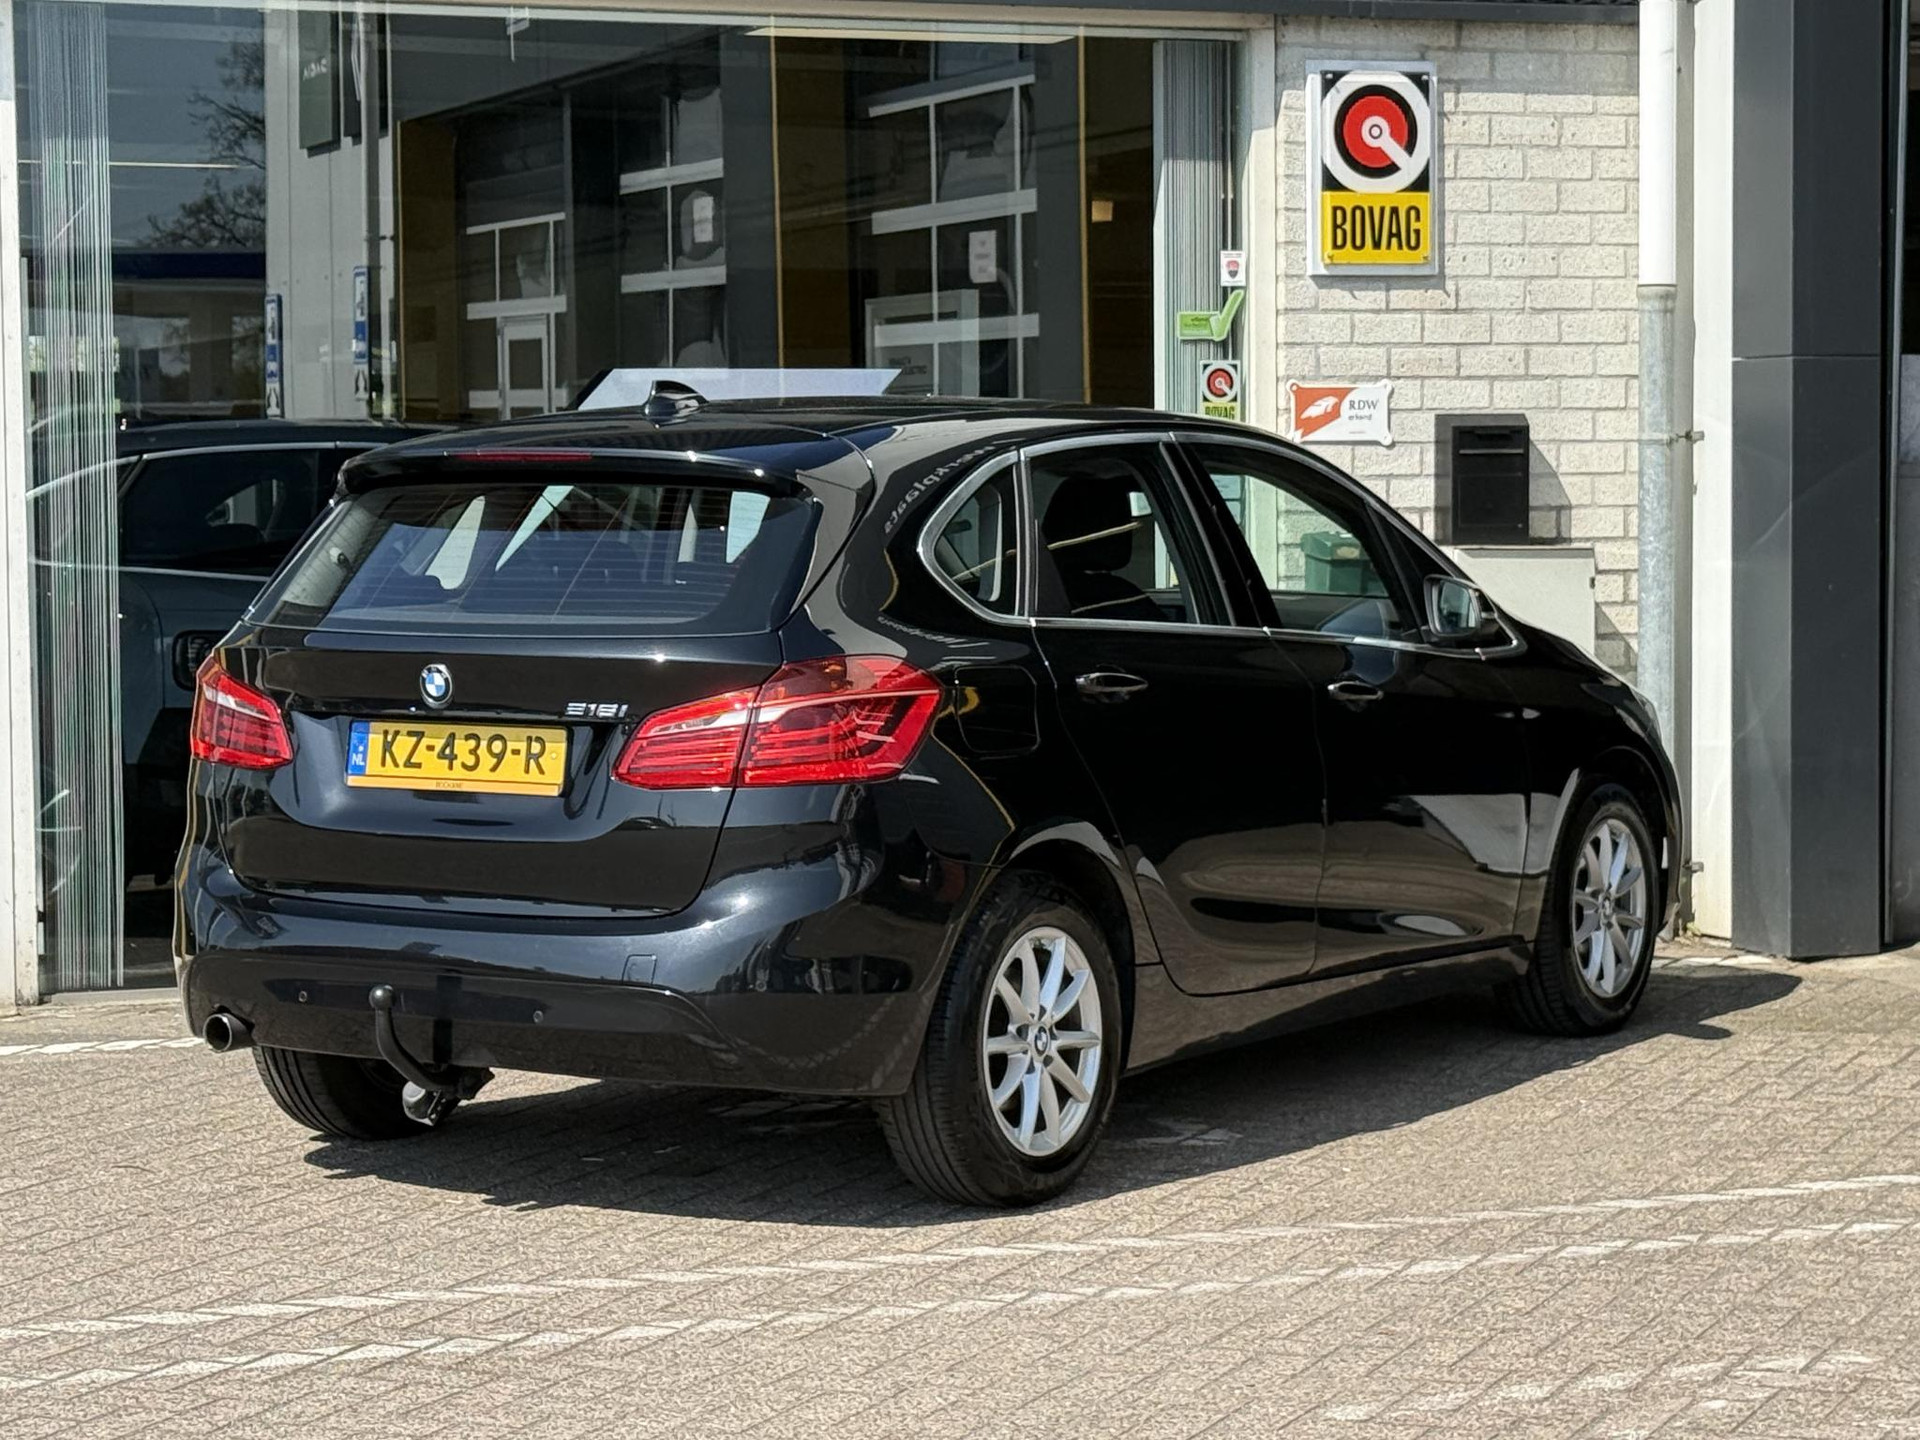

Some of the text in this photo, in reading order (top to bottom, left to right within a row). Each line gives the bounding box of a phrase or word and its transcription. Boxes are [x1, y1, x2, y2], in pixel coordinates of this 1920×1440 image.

[1331, 204, 1421, 251] BOVAG
[1348, 398, 1379, 410] RDW
[1204, 405, 1236, 421] BOVAG
[351, 752, 366, 766] NL
[380, 728, 547, 776] KZ-439-R
